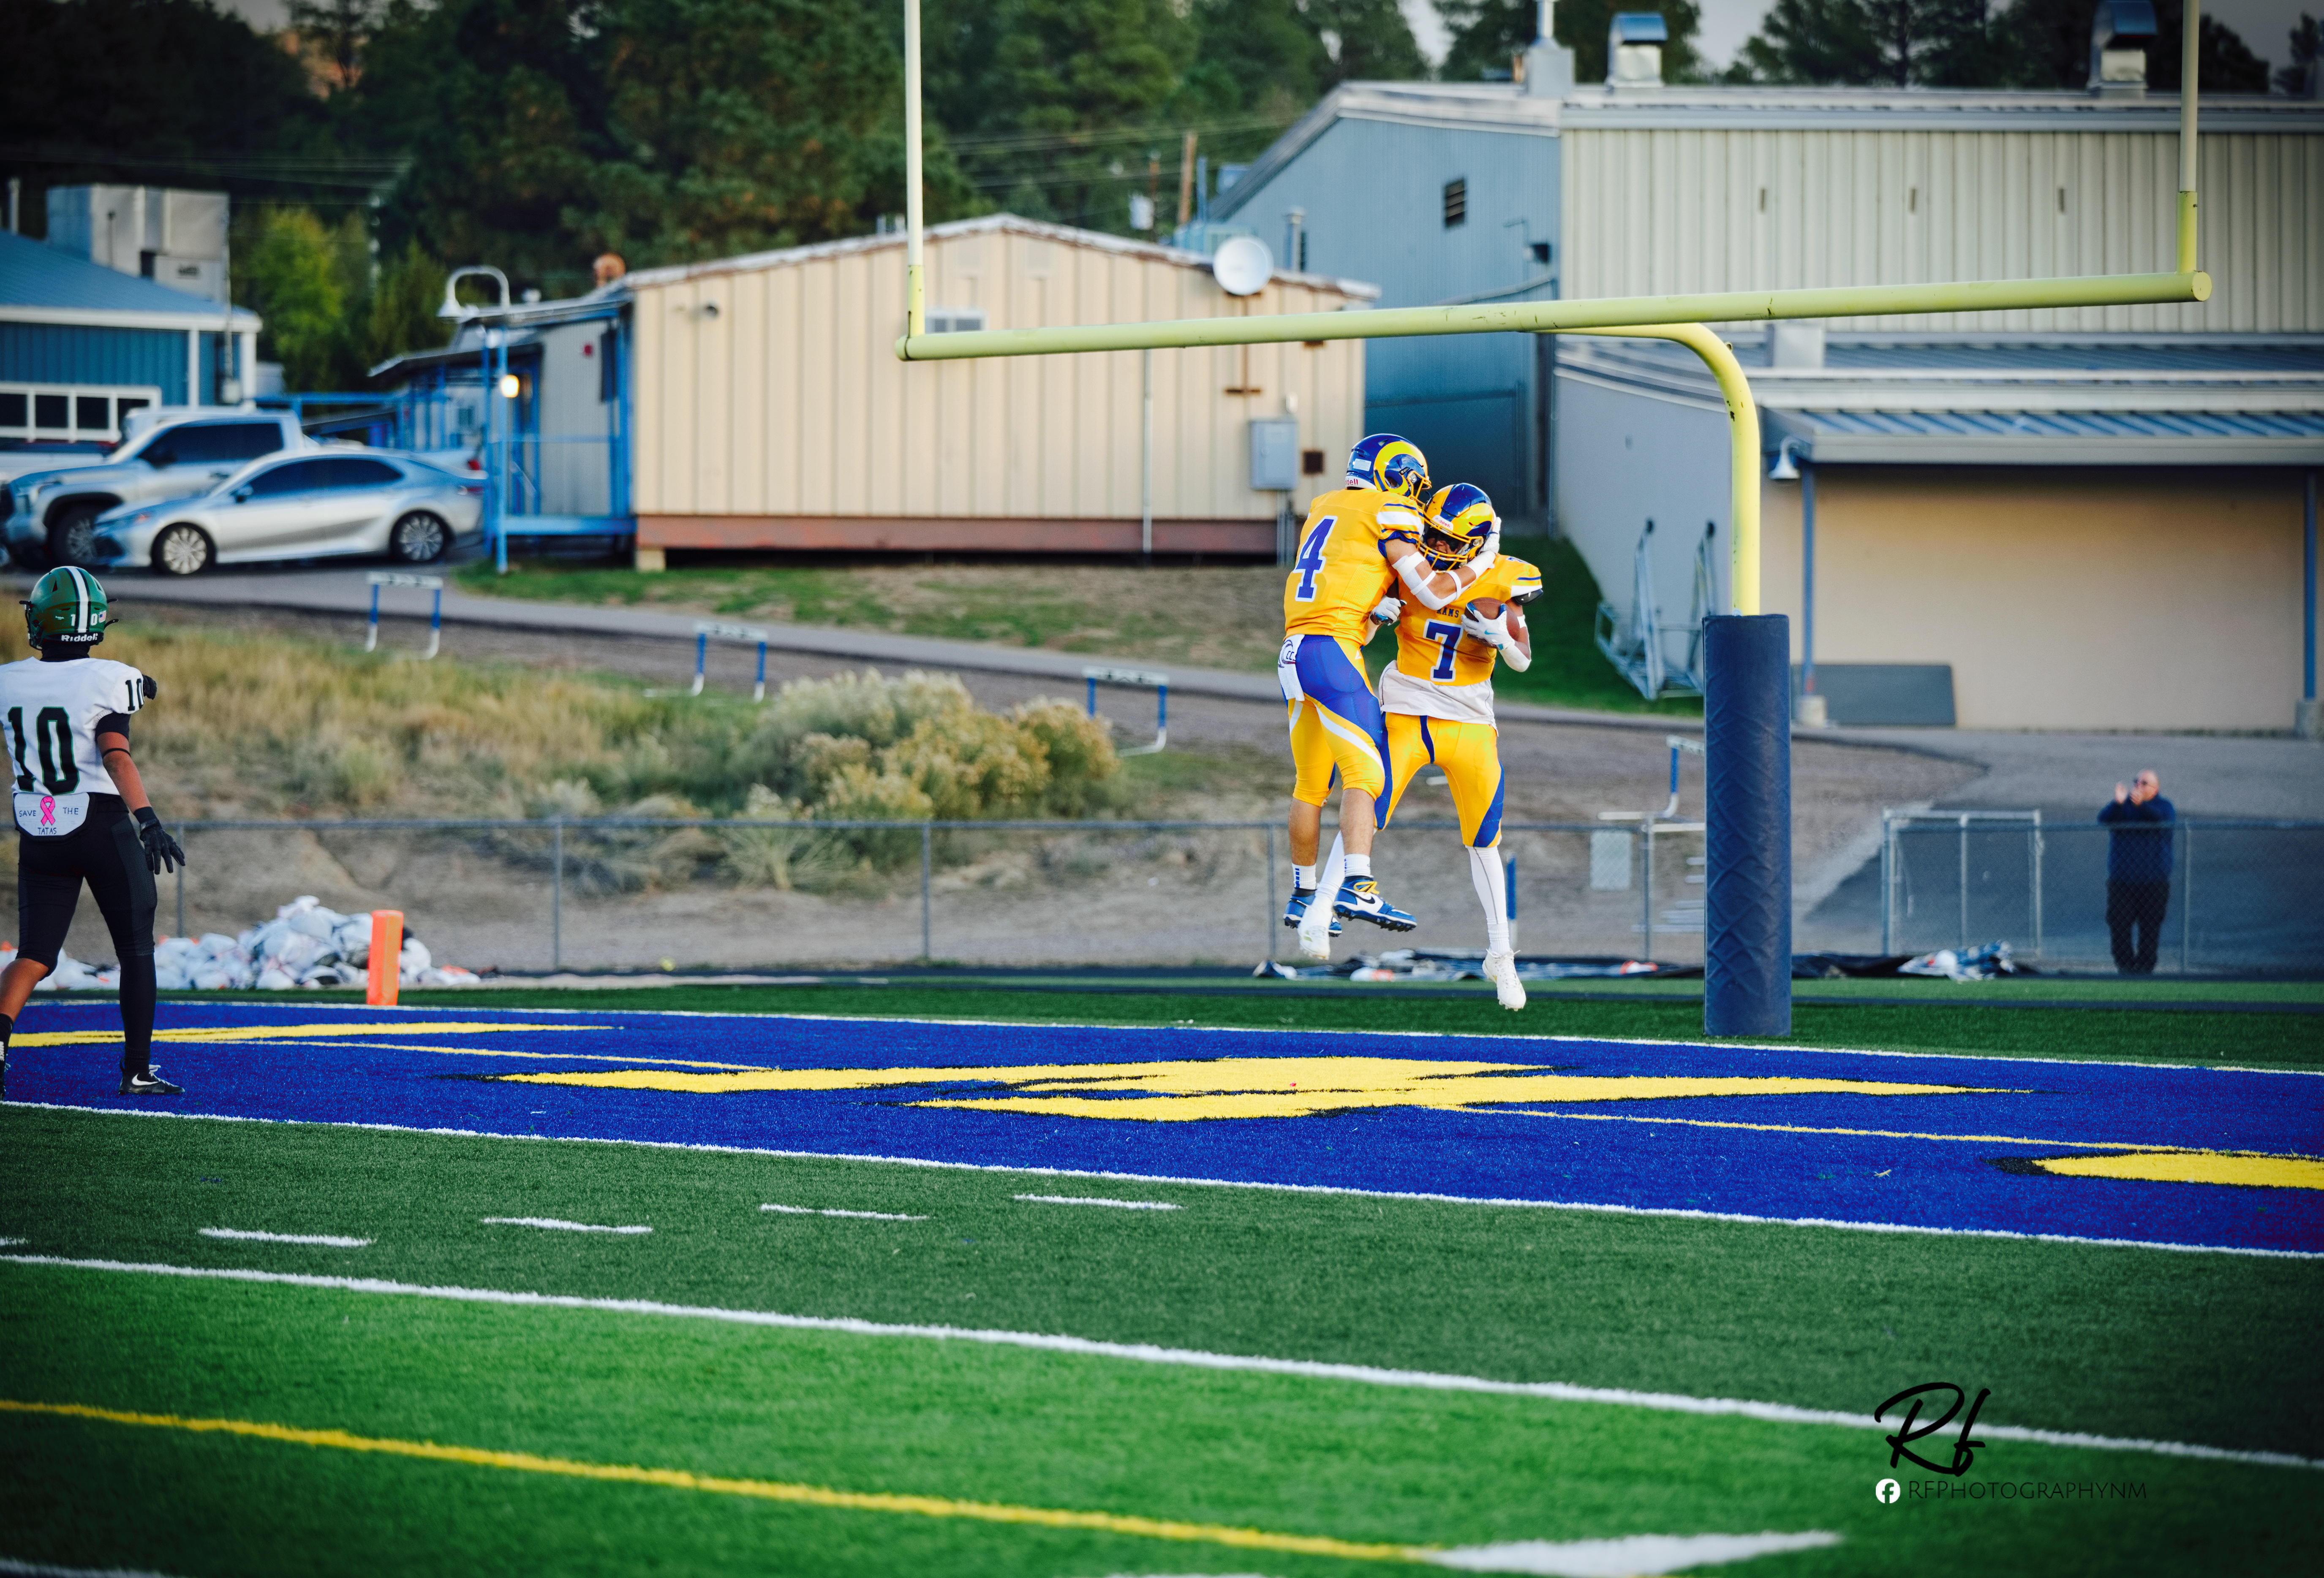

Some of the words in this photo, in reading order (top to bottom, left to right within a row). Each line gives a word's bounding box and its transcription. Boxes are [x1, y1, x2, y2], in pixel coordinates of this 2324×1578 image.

[1293, 515, 1338, 602] 4
[61, 633, 98, 642] Riddell
[1423, 618, 1464, 682] 7
[125, 678, 144, 711] 10
[8, 706, 80, 796] 10
